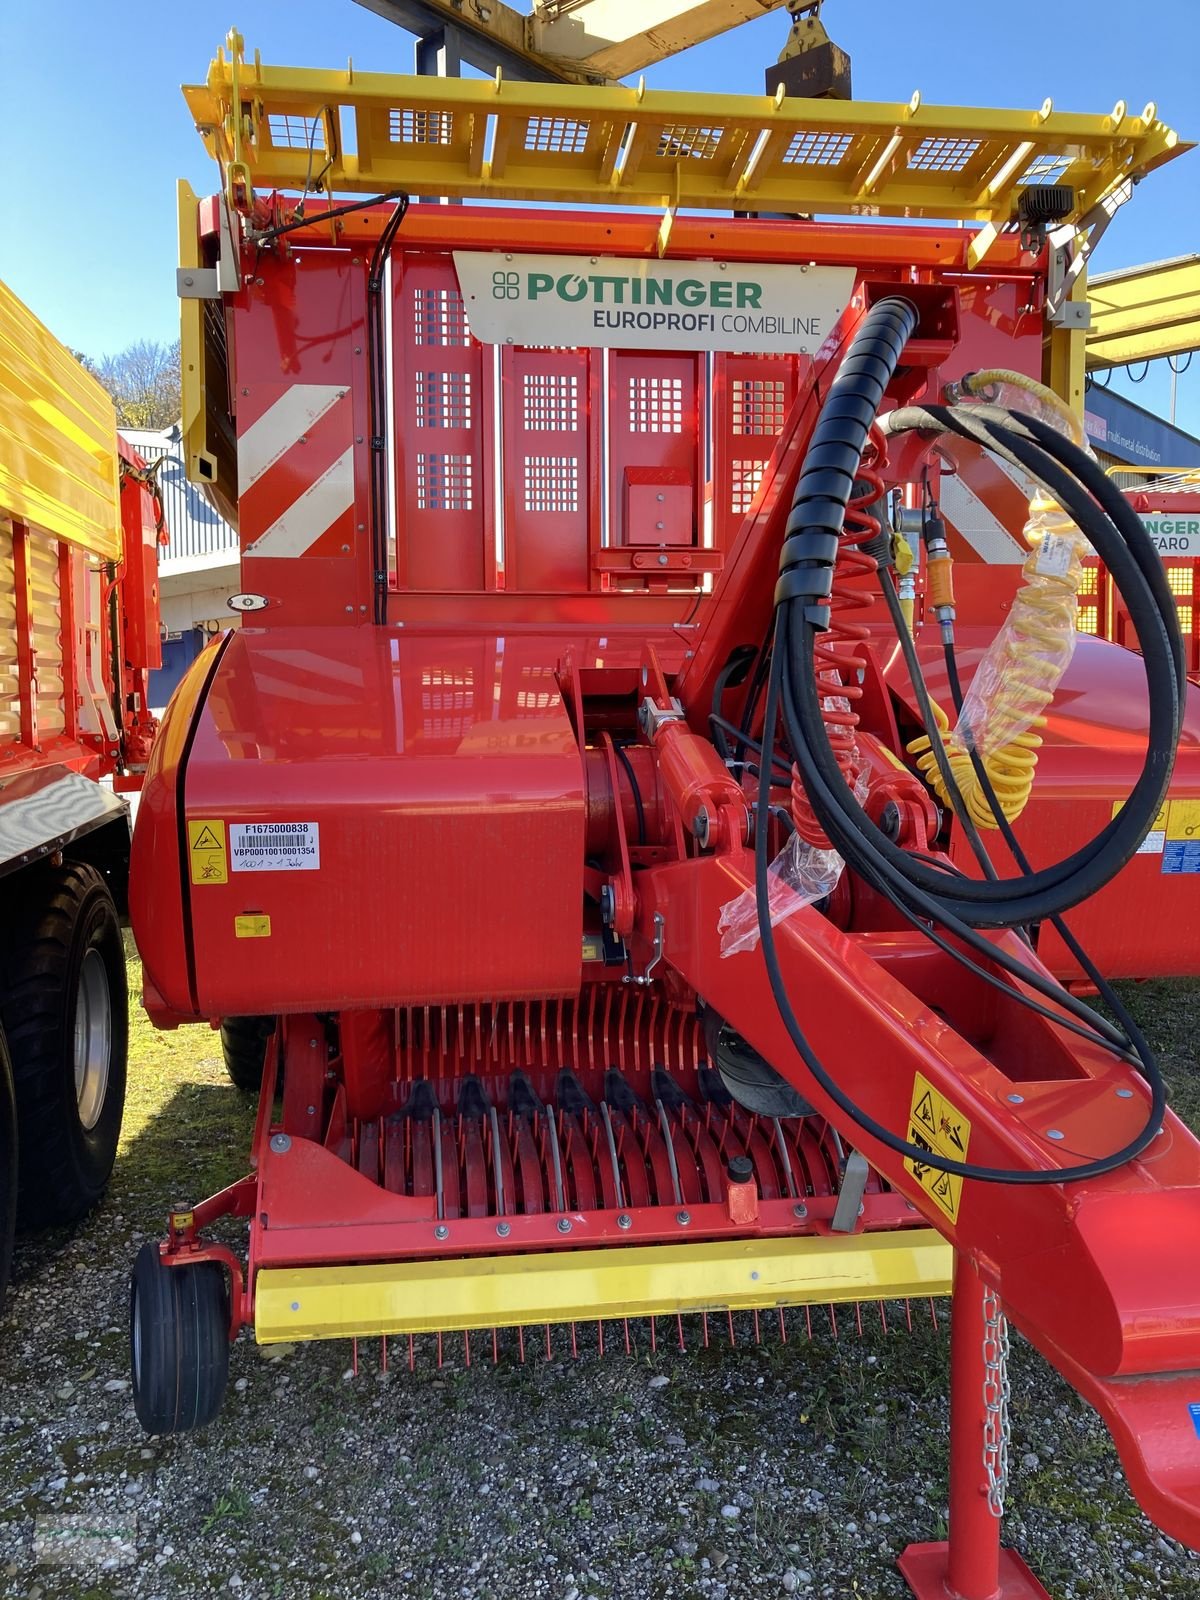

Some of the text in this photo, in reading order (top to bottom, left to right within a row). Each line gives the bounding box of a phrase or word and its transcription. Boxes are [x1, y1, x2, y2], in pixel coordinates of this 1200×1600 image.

[527, 272, 763, 309] PÖTTINGER
[593, 310, 821, 336] EUROPROFI COMBILINE
[1120, 436, 1135, 452] metal
[1145, 520, 1200, 535] NGER
[245, 824, 309, 834] F1675000838
[233, 847, 315, 856] VBP00010010001354
